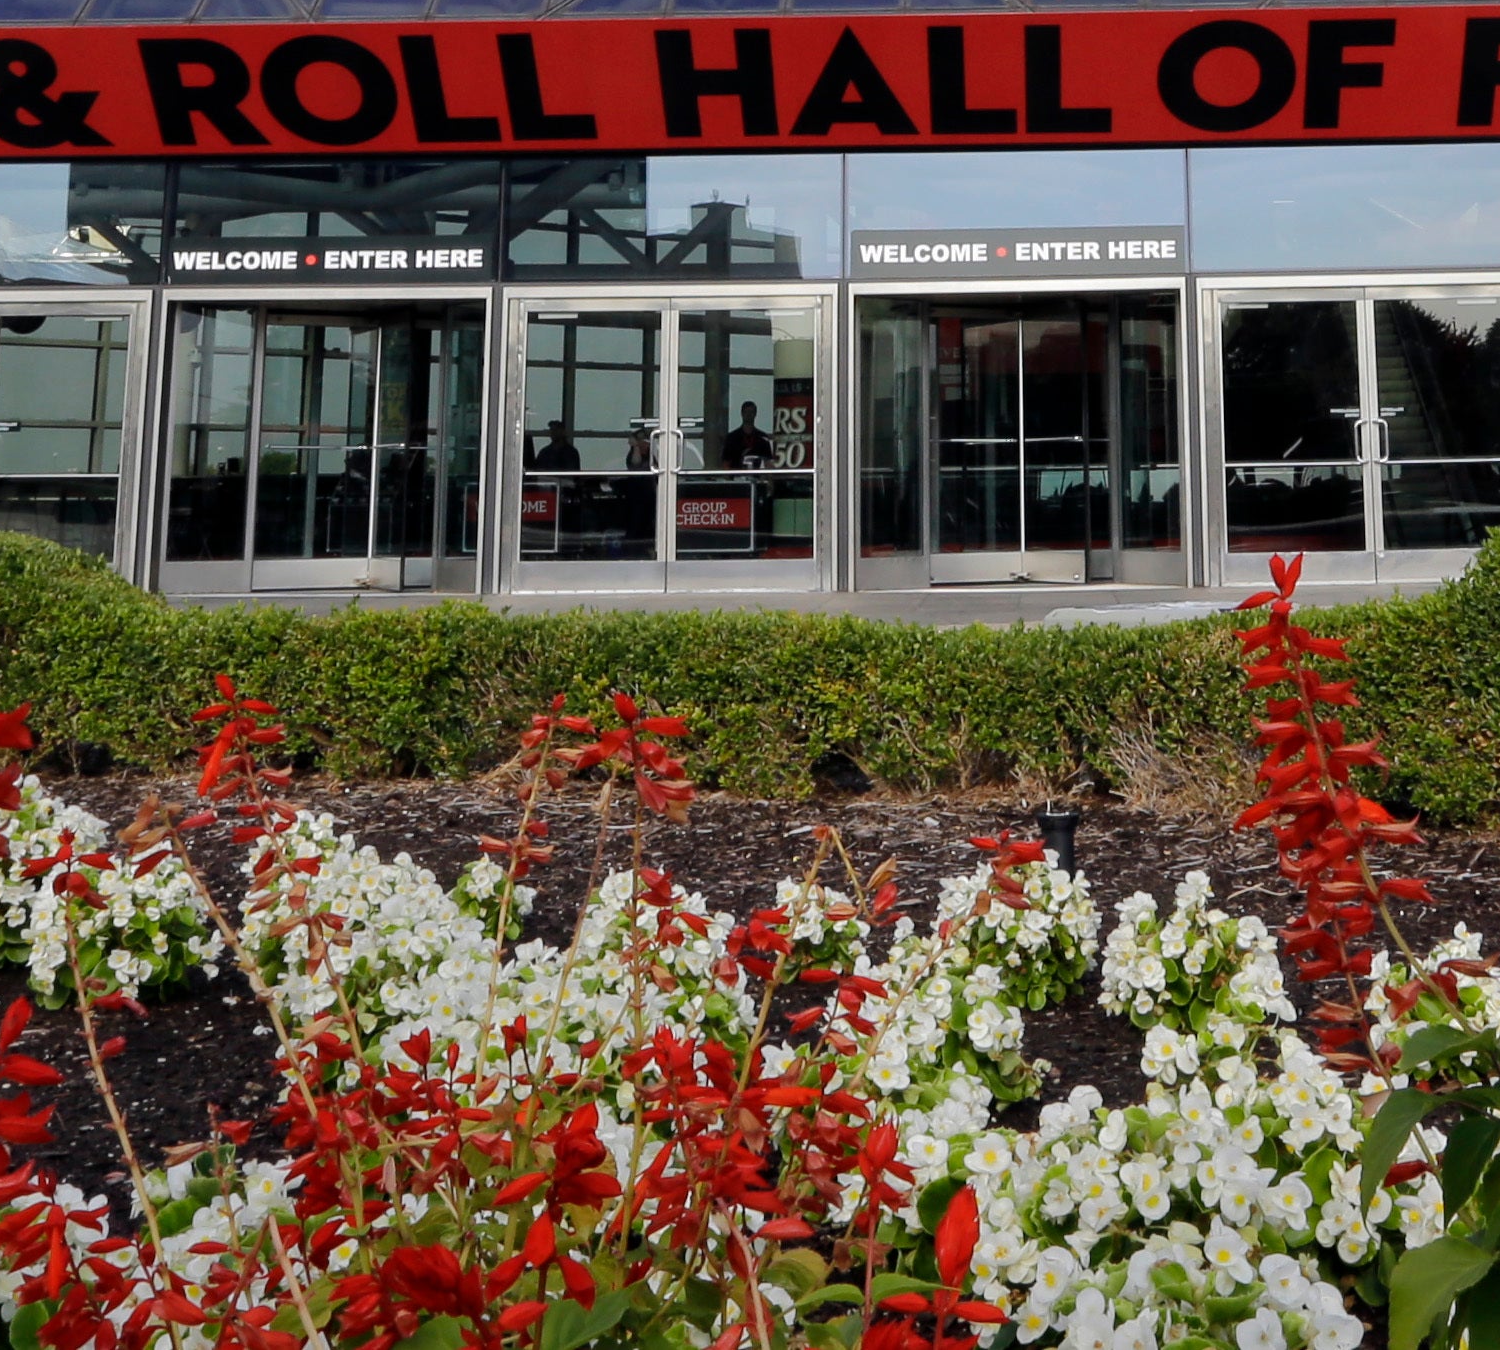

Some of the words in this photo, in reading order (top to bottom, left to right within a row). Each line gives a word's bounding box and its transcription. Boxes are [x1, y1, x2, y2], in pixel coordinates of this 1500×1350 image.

[137, 33, 598, 147] ROLL
[653, 24, 1112, 138] HALL
[1156, 18, 1397, 133] OF
[172, 251, 298, 270] WELCOME
[323, 250, 408, 270] ENTER
[415, 249, 484, 269] HERE
[859, 243, 988, 263] WELCOME
[1015, 241, 1101, 262] ENTER
[1108, 240, 1177, 260] HERE
[775, 406, 808, 434] RS
[773, 441, 806, 468] 50
[681, 501, 728, 513] GROUP
